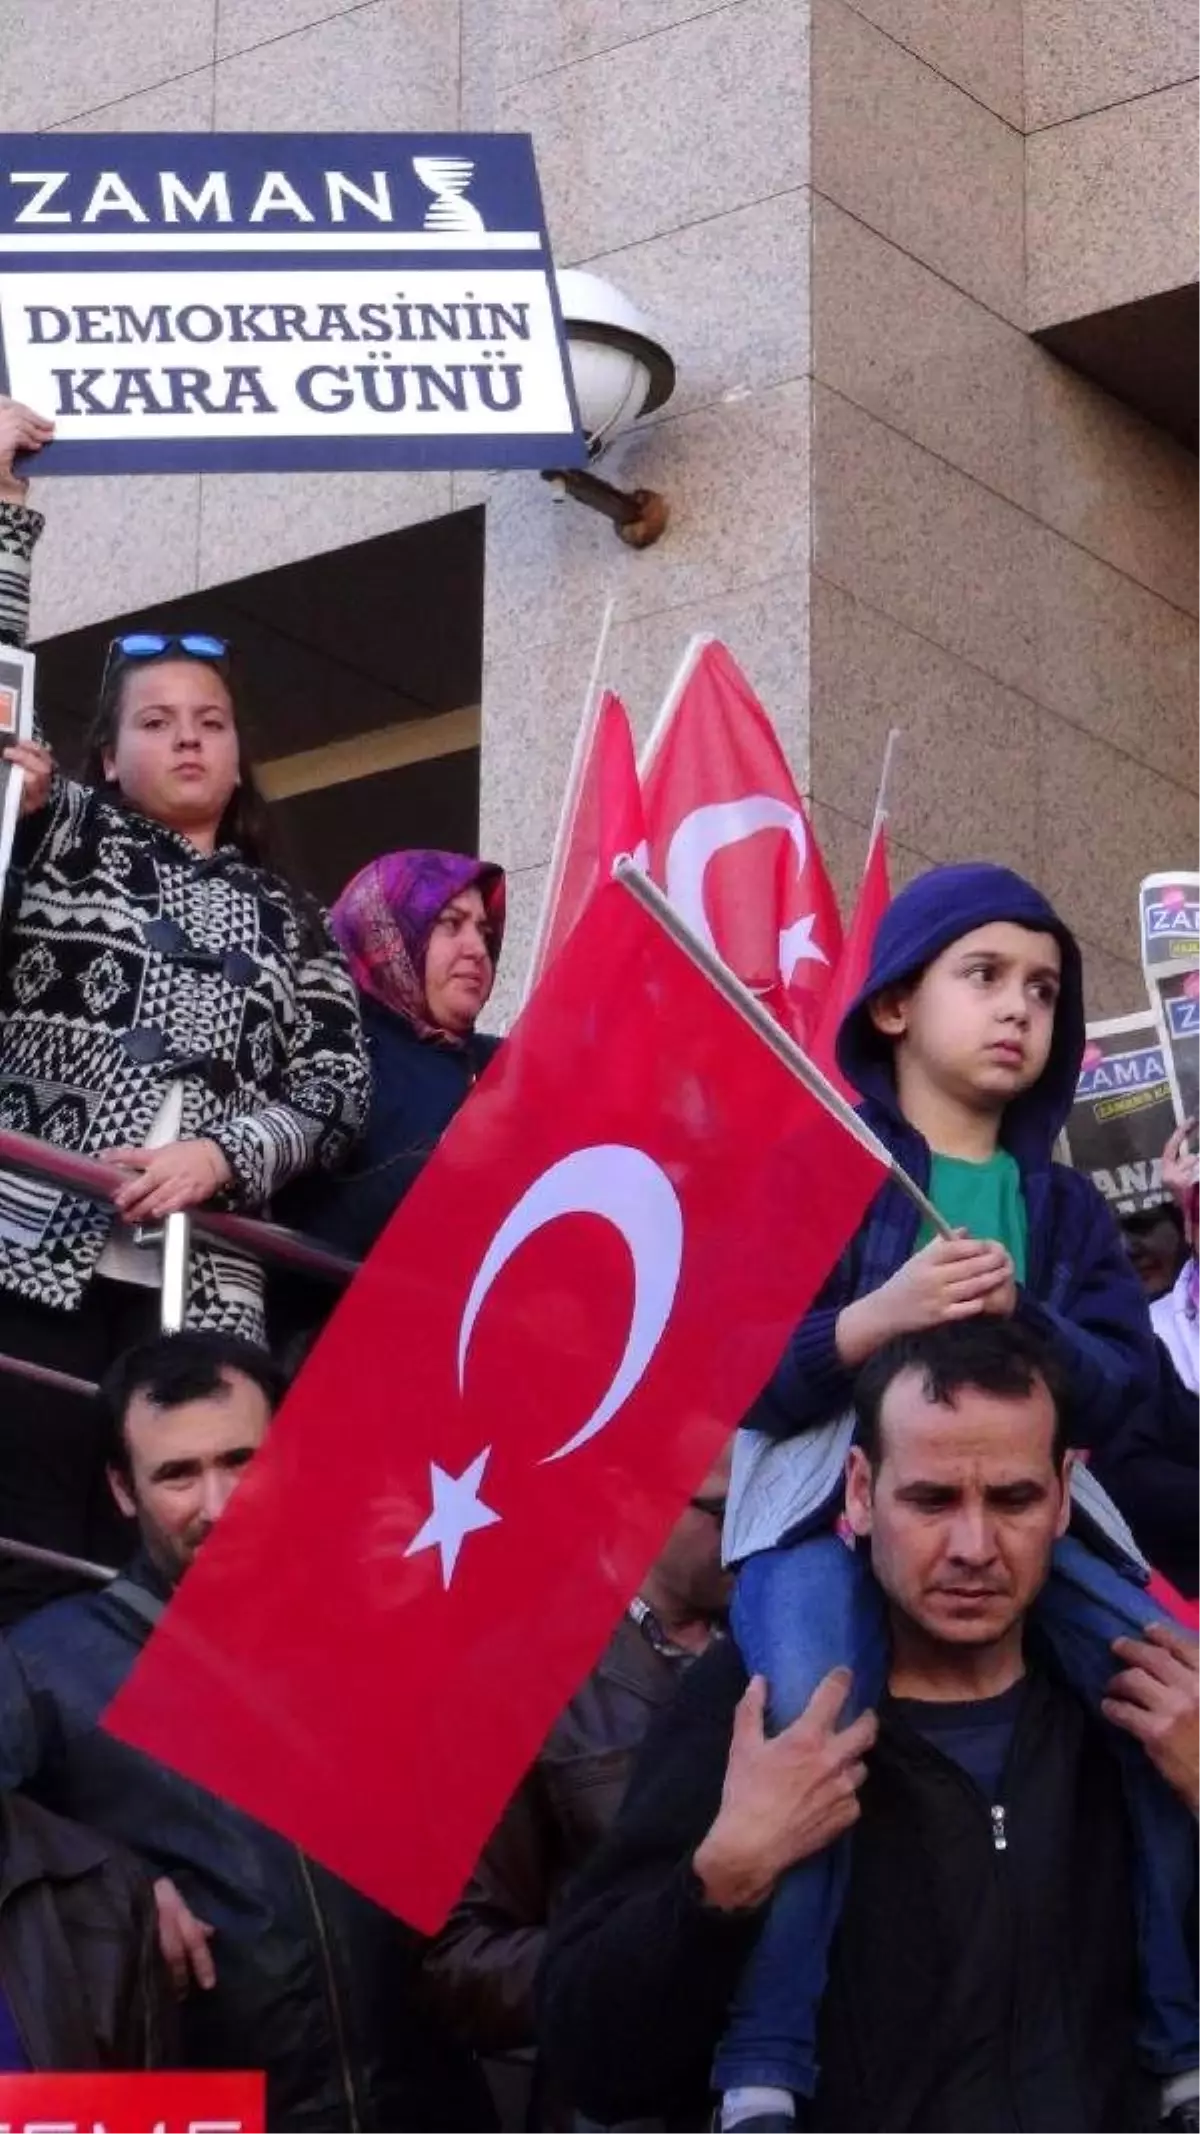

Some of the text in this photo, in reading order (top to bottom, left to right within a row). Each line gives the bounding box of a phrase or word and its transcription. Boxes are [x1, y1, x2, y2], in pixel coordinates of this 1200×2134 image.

[9, 171, 393, 222] ZAMAN
[24, 291, 531, 344] DEMOKRASİNİN
[50, 350, 524, 416] KARA GÜNÜ
